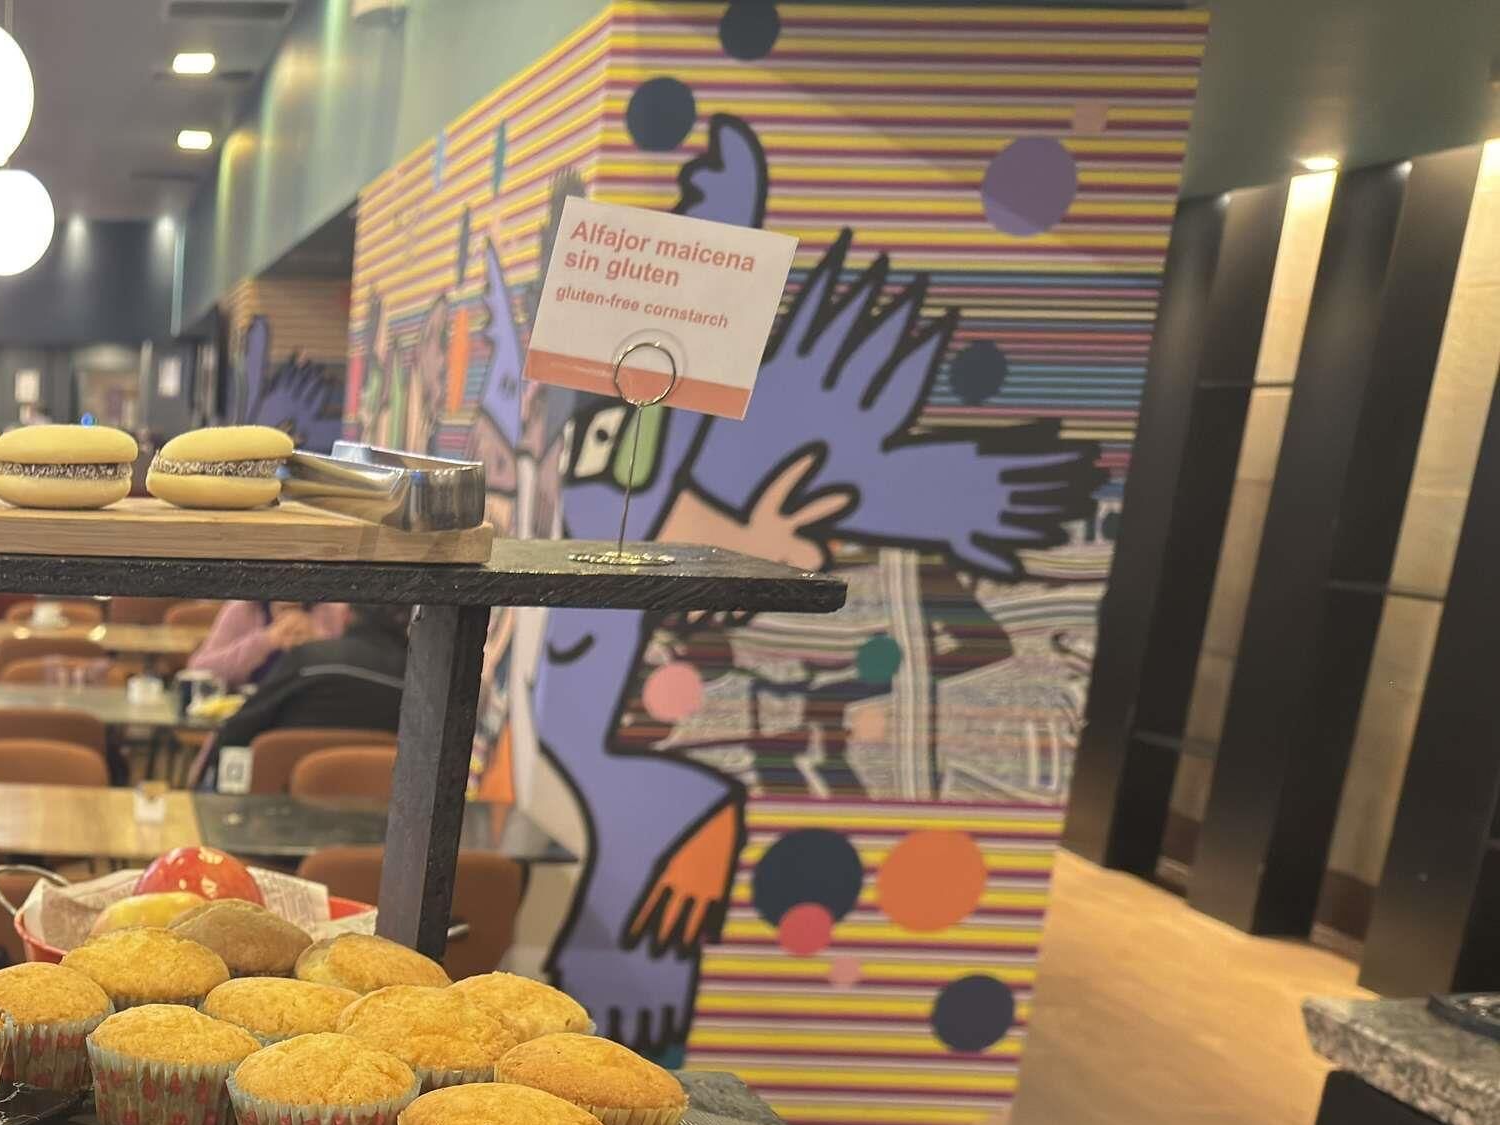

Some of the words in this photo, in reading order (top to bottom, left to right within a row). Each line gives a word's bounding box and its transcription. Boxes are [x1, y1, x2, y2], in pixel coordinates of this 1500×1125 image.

[570, 220, 652, 253] Alfajor
[655, 240, 755, 272] maicena
[564, 250, 599, 272] sin
[606, 256, 679, 287] gluten
[556, 285, 639, 312] gluten-free
[643, 300, 728, 328] cornstarch
